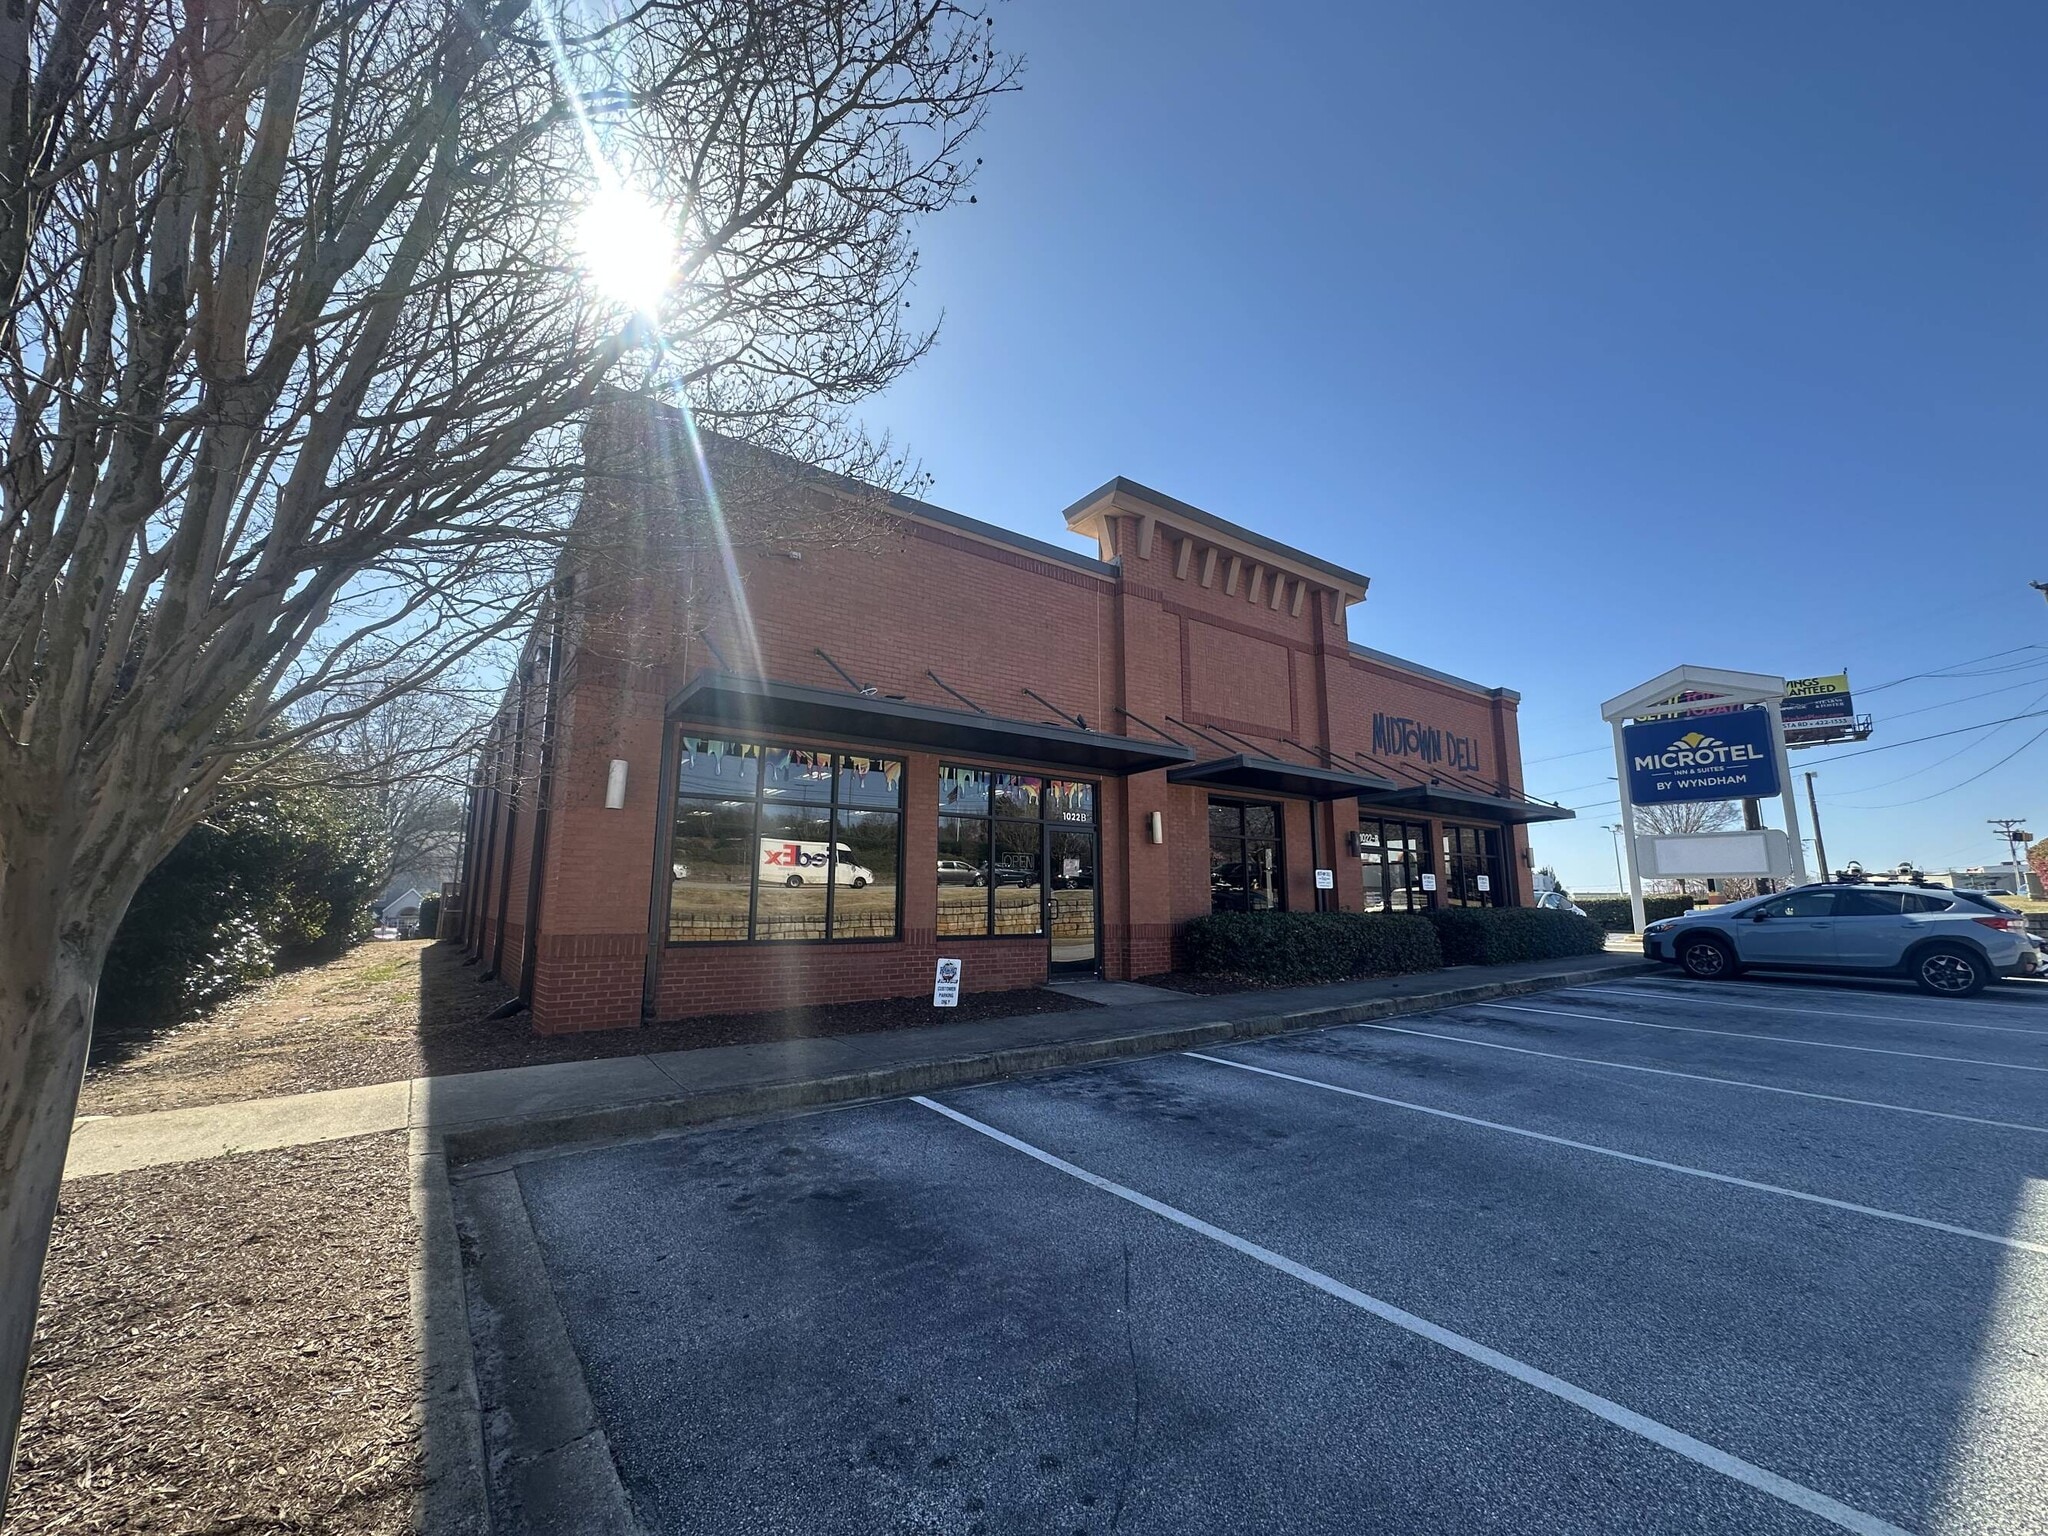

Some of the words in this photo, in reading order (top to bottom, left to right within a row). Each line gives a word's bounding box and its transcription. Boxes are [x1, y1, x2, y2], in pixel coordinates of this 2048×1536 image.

[1372, 712, 1442, 765] MIDTOWN
[1446, 731, 1479, 772] DELI
[1634, 744, 1764, 771] MICROTEL
[1697, 766, 1724, 774] SUITES
[1656, 781, 1672, 791] BY
[1677, 774, 1747, 788] WYNDHAM
[1063, 812, 1087, 822] 1022B
